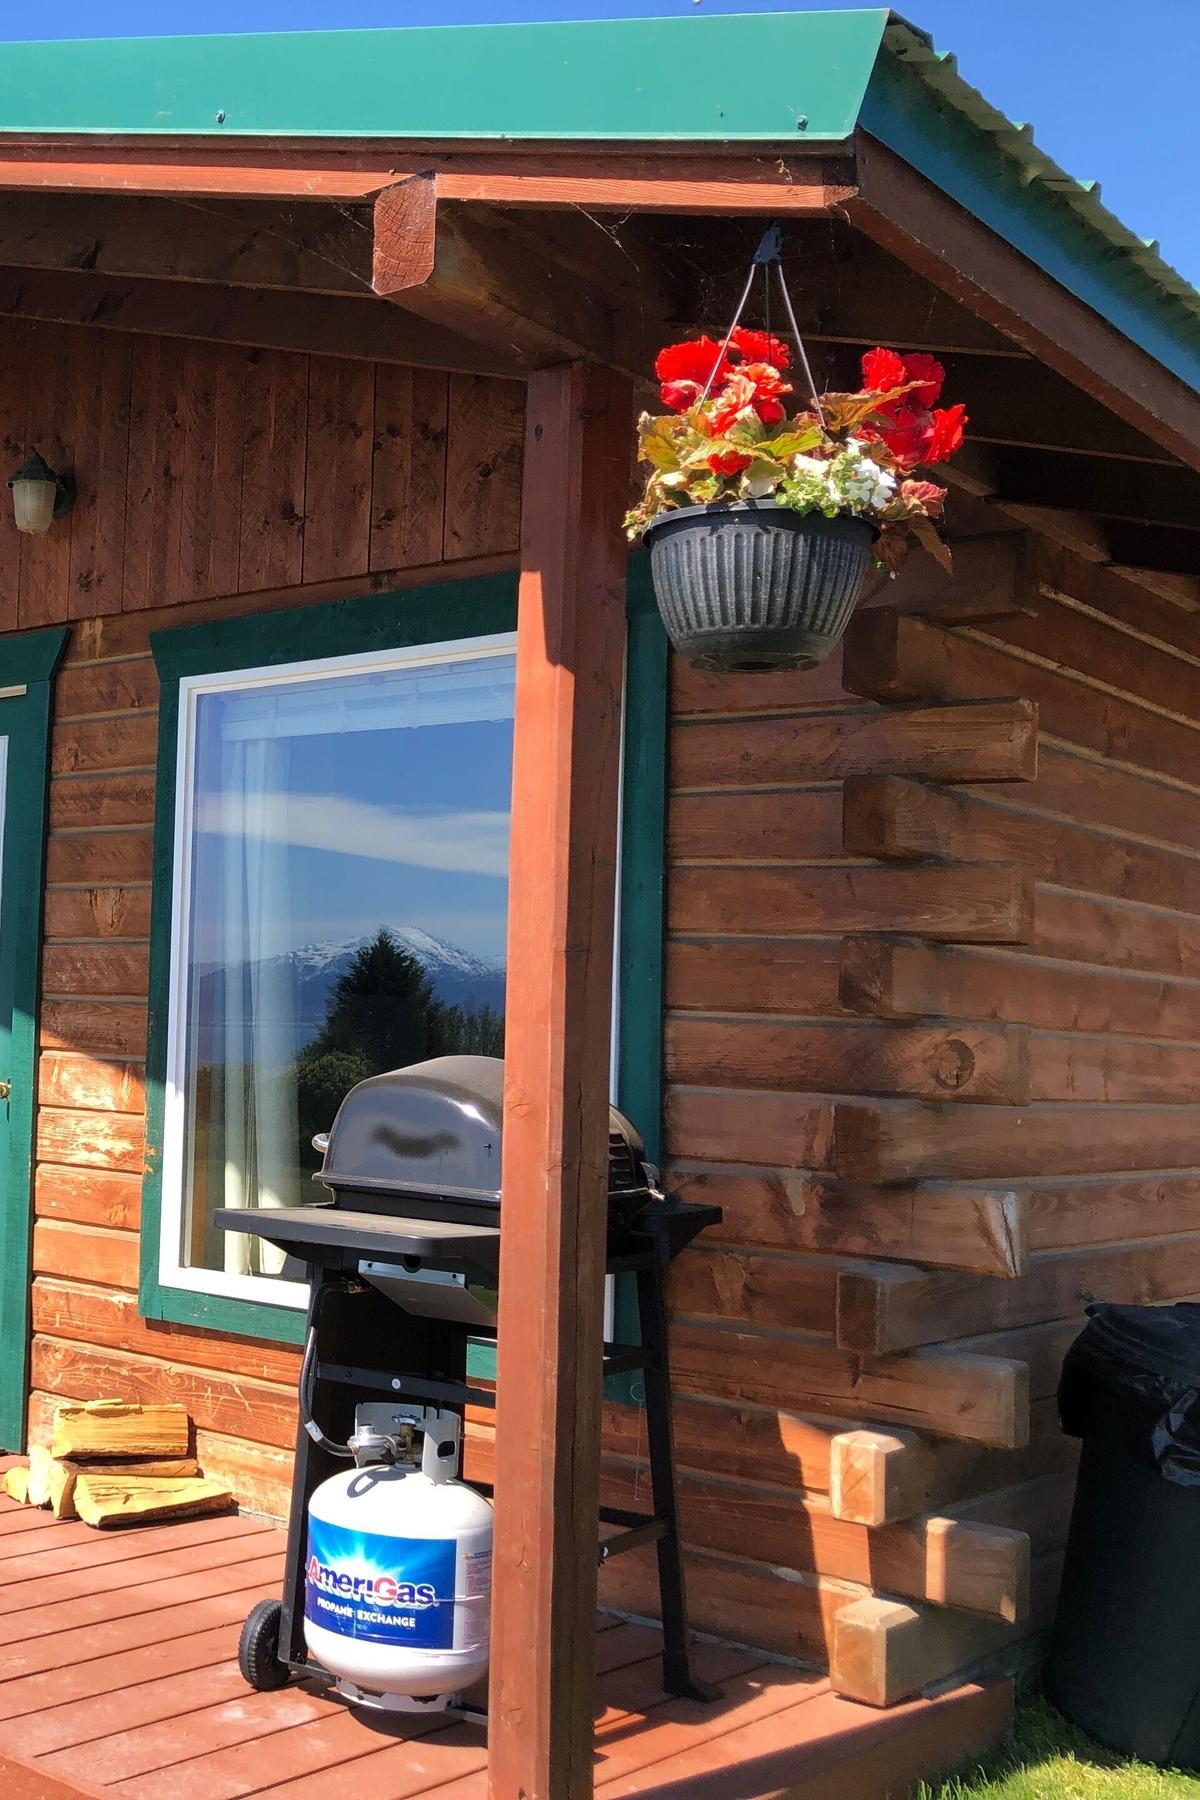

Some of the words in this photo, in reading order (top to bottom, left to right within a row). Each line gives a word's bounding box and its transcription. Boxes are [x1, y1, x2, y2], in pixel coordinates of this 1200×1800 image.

[306, 1555, 435, 1607] AmeriGas
[317, 1597, 353, 1617] PROPANE
[357, 1609, 416, 1628] EXCHANGE
